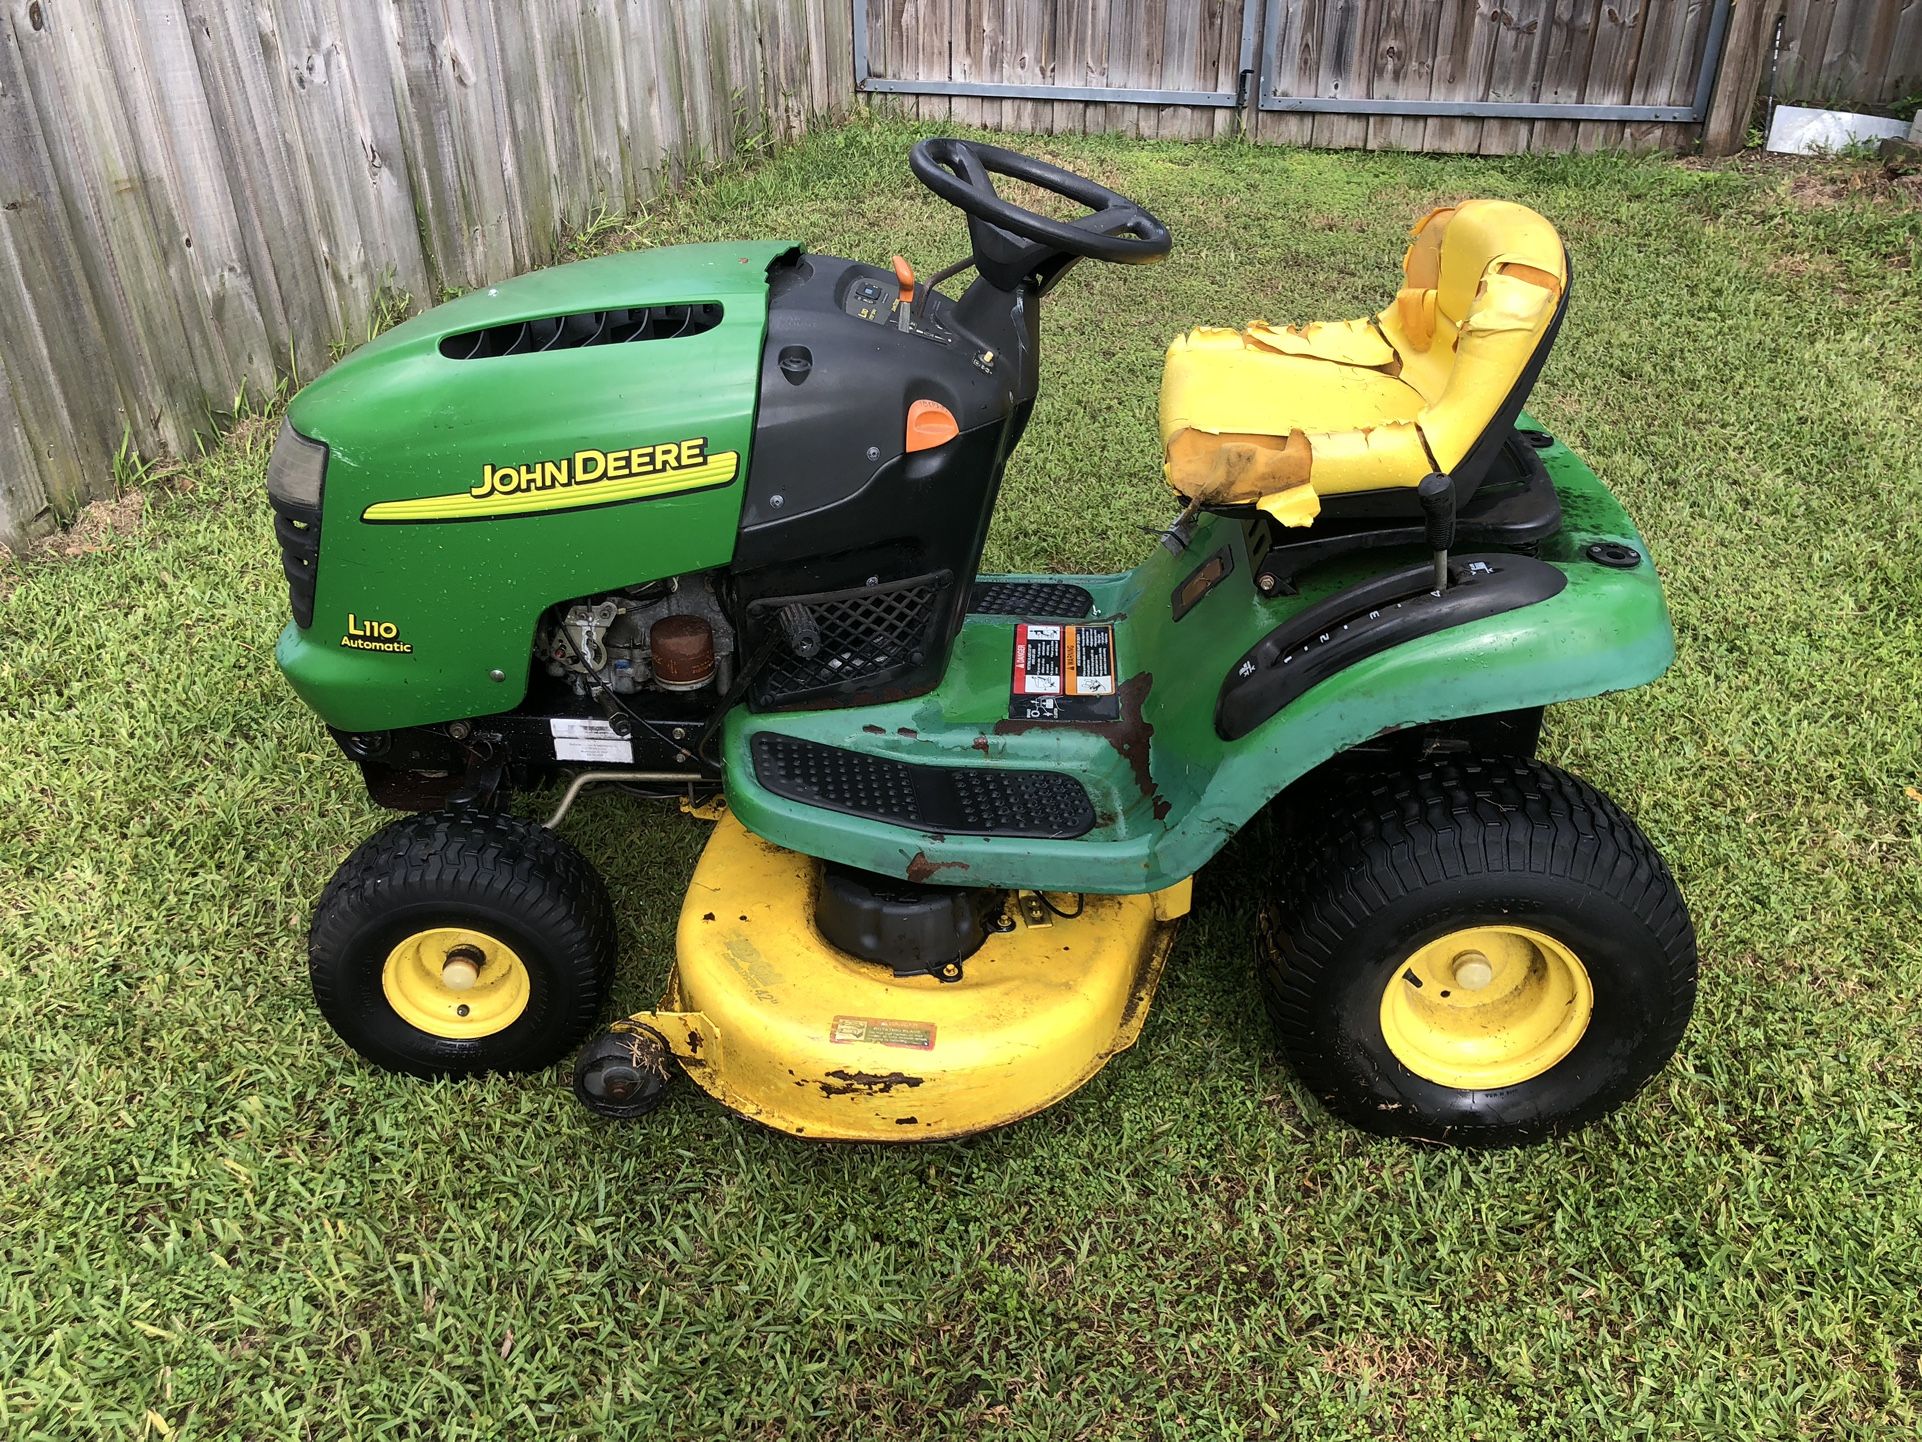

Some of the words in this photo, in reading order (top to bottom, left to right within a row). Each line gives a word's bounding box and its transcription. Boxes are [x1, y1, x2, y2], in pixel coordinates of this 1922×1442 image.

[470, 459, 570, 498] JOHN
[573, 437, 706, 485] DEERE
[348, 613, 398, 639] L110
[1283, 655, 1293, 664] 1
[1319, 632, 1330, 644] 2
[1369, 610, 1380, 620] 3
[341, 635, 412, 653] Automatic
[1016, 644, 1026, 664] DANGER
[1066, 645, 1075, 666] WARNING
